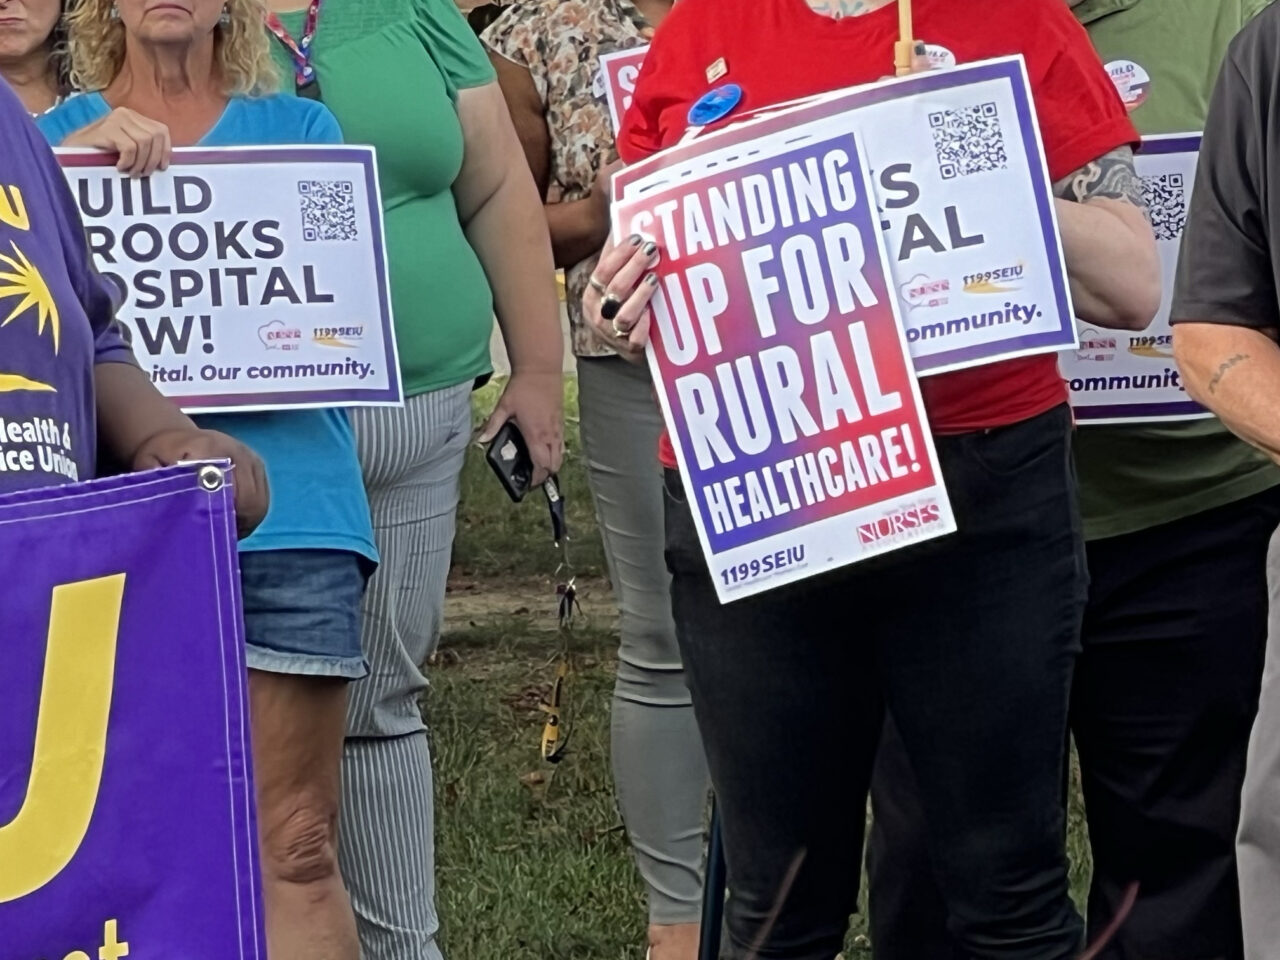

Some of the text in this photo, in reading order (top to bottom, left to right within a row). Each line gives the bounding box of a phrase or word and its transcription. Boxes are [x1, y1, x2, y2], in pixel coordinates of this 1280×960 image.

[79, 175, 212, 218] UILD
[86, 220, 284, 263] ROOKS
[100, 265, 334, 310] SPITAL
[652, 262, 729, 366] UP
[740, 221, 877, 338] FOR
[962, 265, 1023, 285] 1199SEIU
[118, 315, 214, 356] W!
[906, 302, 1042, 343] ommunity.
[1129, 334, 1173, 348] 1199SE
[152, 357, 375, 382] ital. Our community.
[1069, 368, 1185, 391] ommunit
[674, 321, 902, 470] RURAL
[37, 445, 79, 482] Union
[703, 423, 922, 535] HEALTHCARE!
[857, 504, 942, 544] NURSES
[720, 544, 805, 585] 1199SEIU
